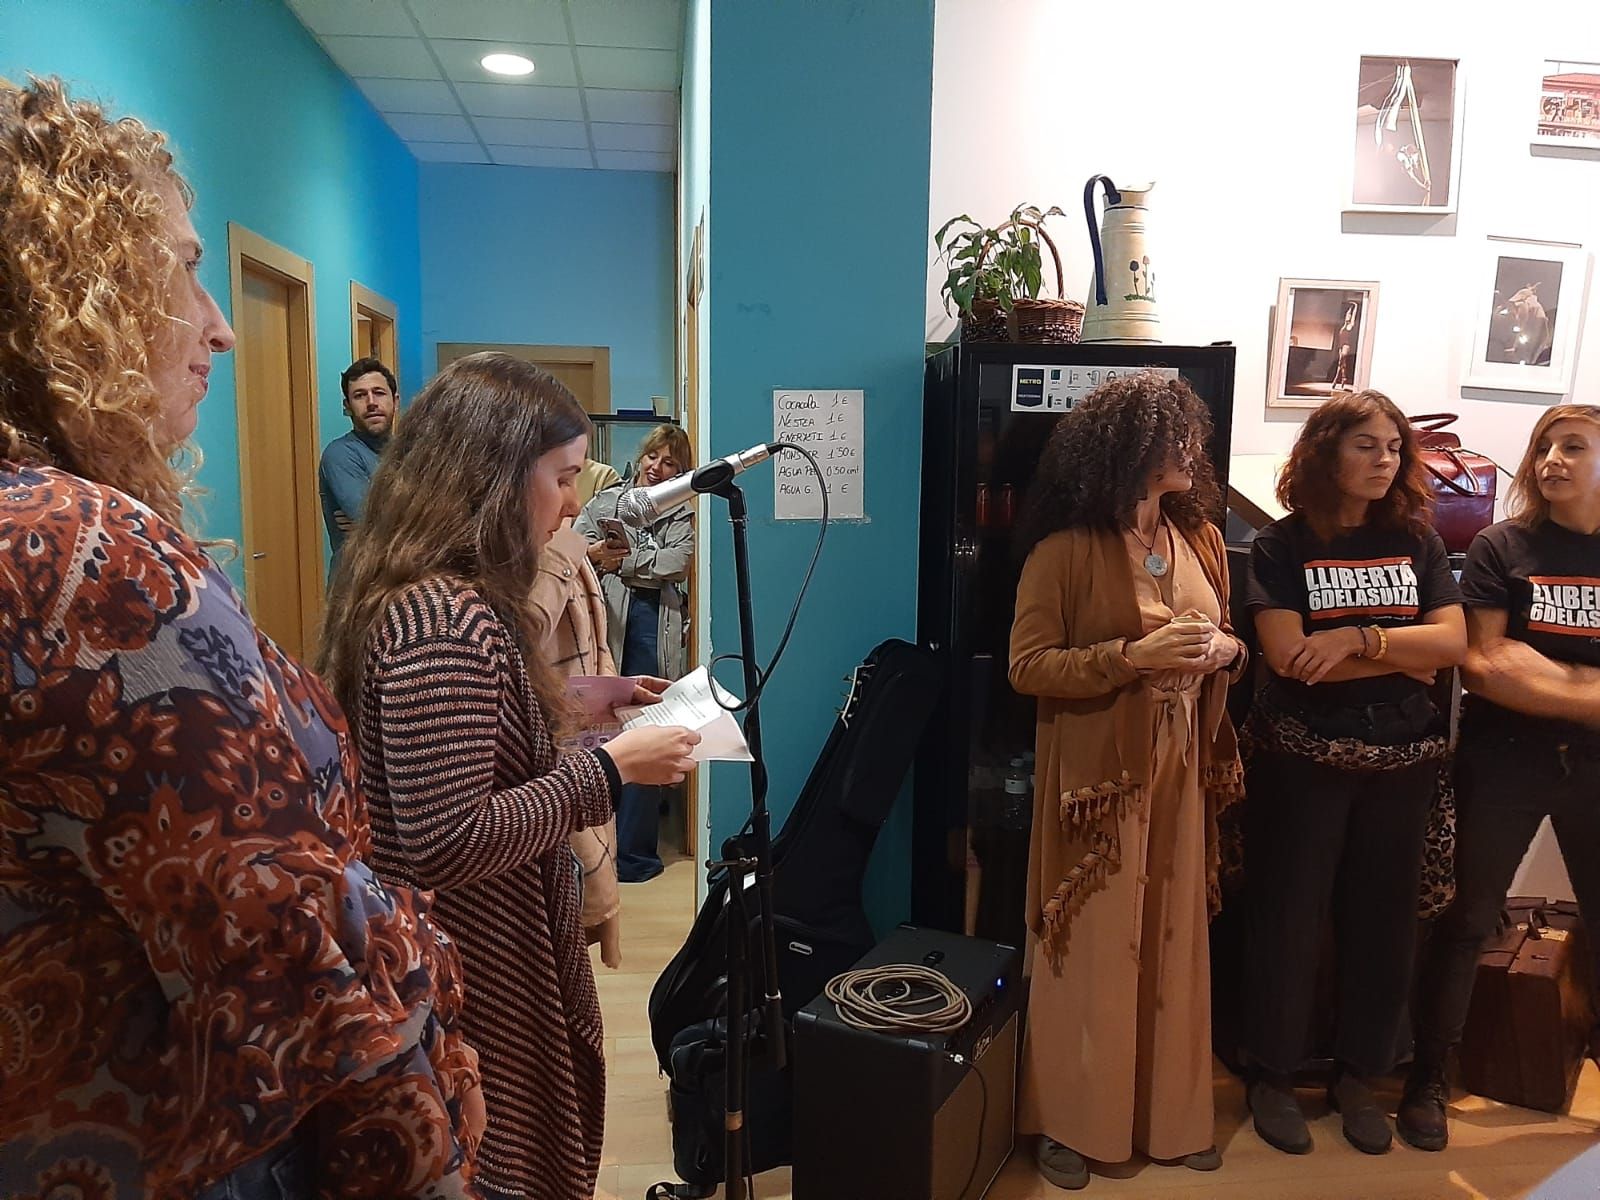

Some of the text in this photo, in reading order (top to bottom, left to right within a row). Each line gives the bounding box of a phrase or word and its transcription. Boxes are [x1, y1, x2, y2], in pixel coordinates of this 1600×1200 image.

[831, 392, 839, 408] 1
[826, 411, 836, 425] 1
[829, 429, 839, 441] 1
[778, 465, 802, 478] AGUA
[779, 483, 802, 495] AGUA
[1308, 586, 1419, 611] 6DELASUIZA
